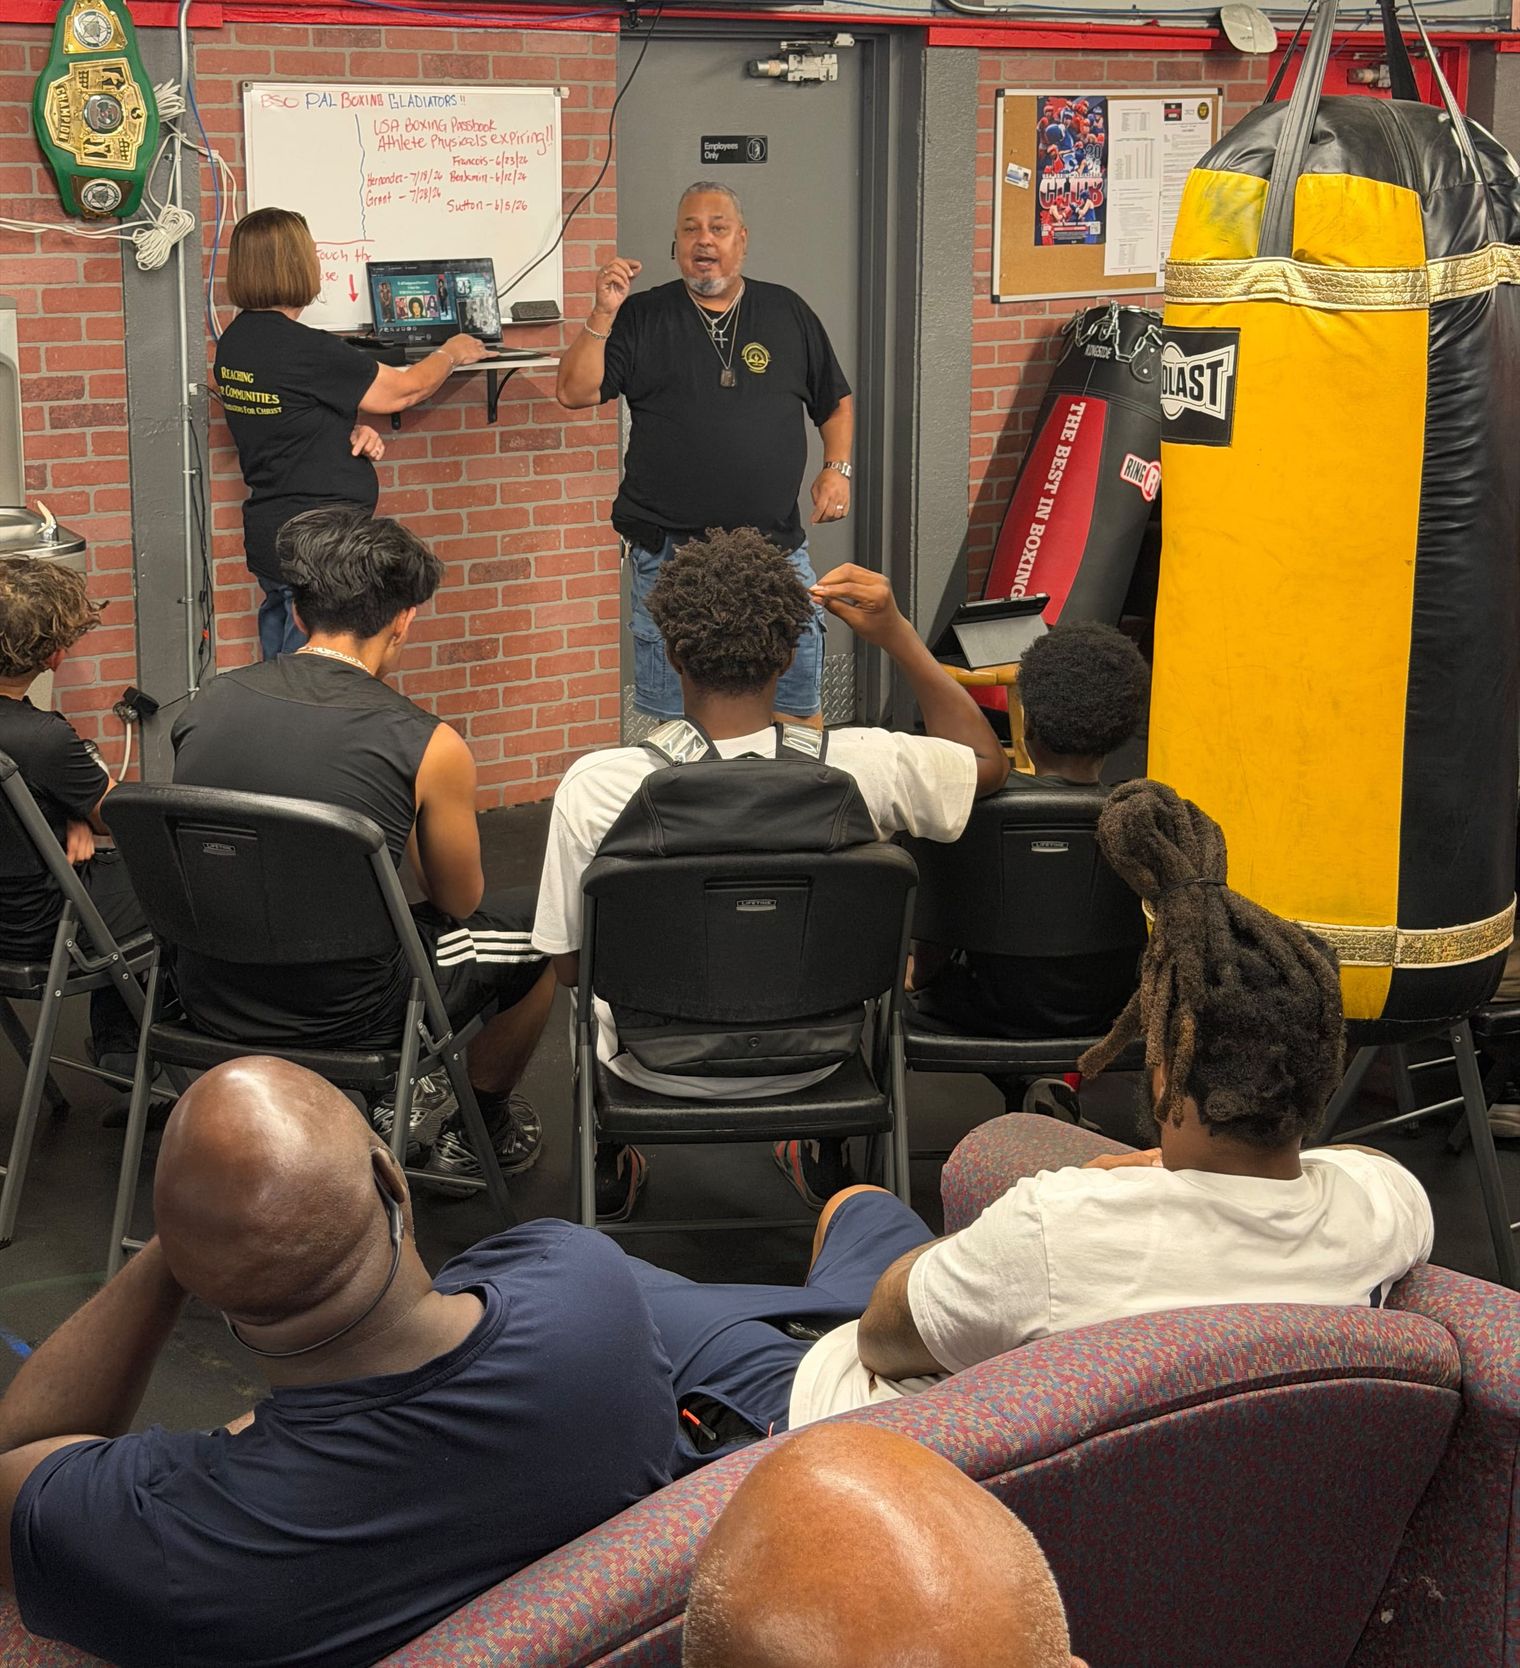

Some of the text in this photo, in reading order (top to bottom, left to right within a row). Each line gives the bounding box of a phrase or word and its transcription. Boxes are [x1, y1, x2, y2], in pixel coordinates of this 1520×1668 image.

[305, 92, 337, 109] PAL
[57, 87, 71, 141] CHAMPION
[373, 116, 497, 135] USA BOXING Passbook
[378, 134, 427, 152] Athlete
[431, 133, 488, 152] Physicals
[704, 142, 738, 151] Employees
[1086, 144, 1101, 159] 20
[704, 151, 719, 160] Only
[1039, 178, 1104, 209] CLUB
[447, 199, 483, 213] Sutton
[225, 385, 280, 405] COMMUNITIES
[256, 406, 282, 415] CHRIST
[1126, 457, 1147, 483] RING
[1010, 402, 1087, 600] THE BEST IN BOXING
